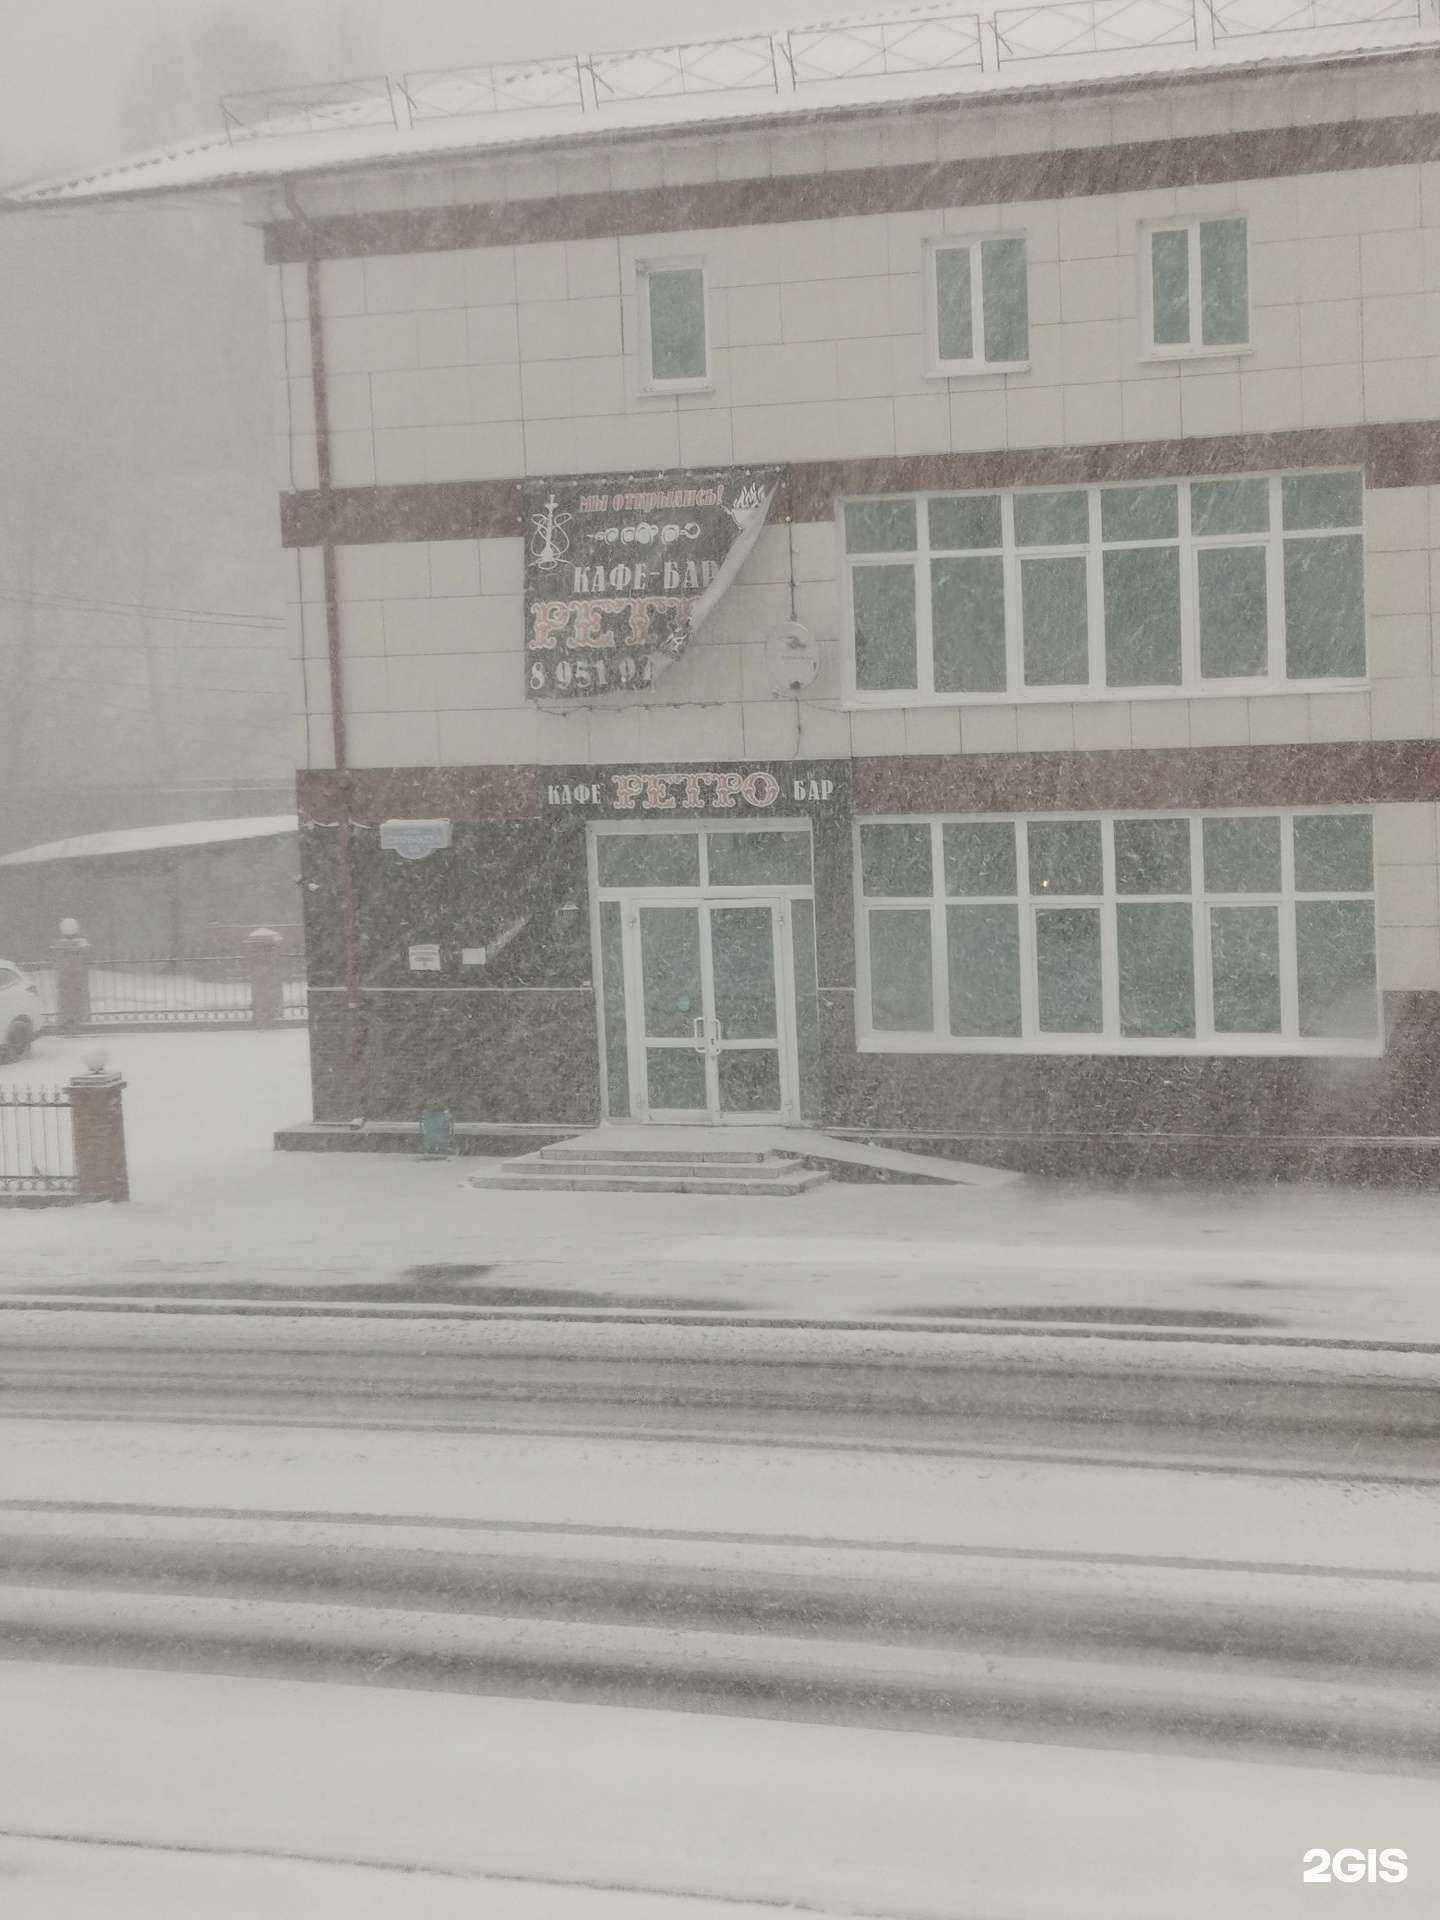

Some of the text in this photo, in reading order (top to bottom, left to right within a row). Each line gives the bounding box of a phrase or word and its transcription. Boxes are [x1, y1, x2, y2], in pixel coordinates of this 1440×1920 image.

[530, 661, 545, 690] 8
[548, 772, 834, 809] КАФЕ РЕТРО БАР
